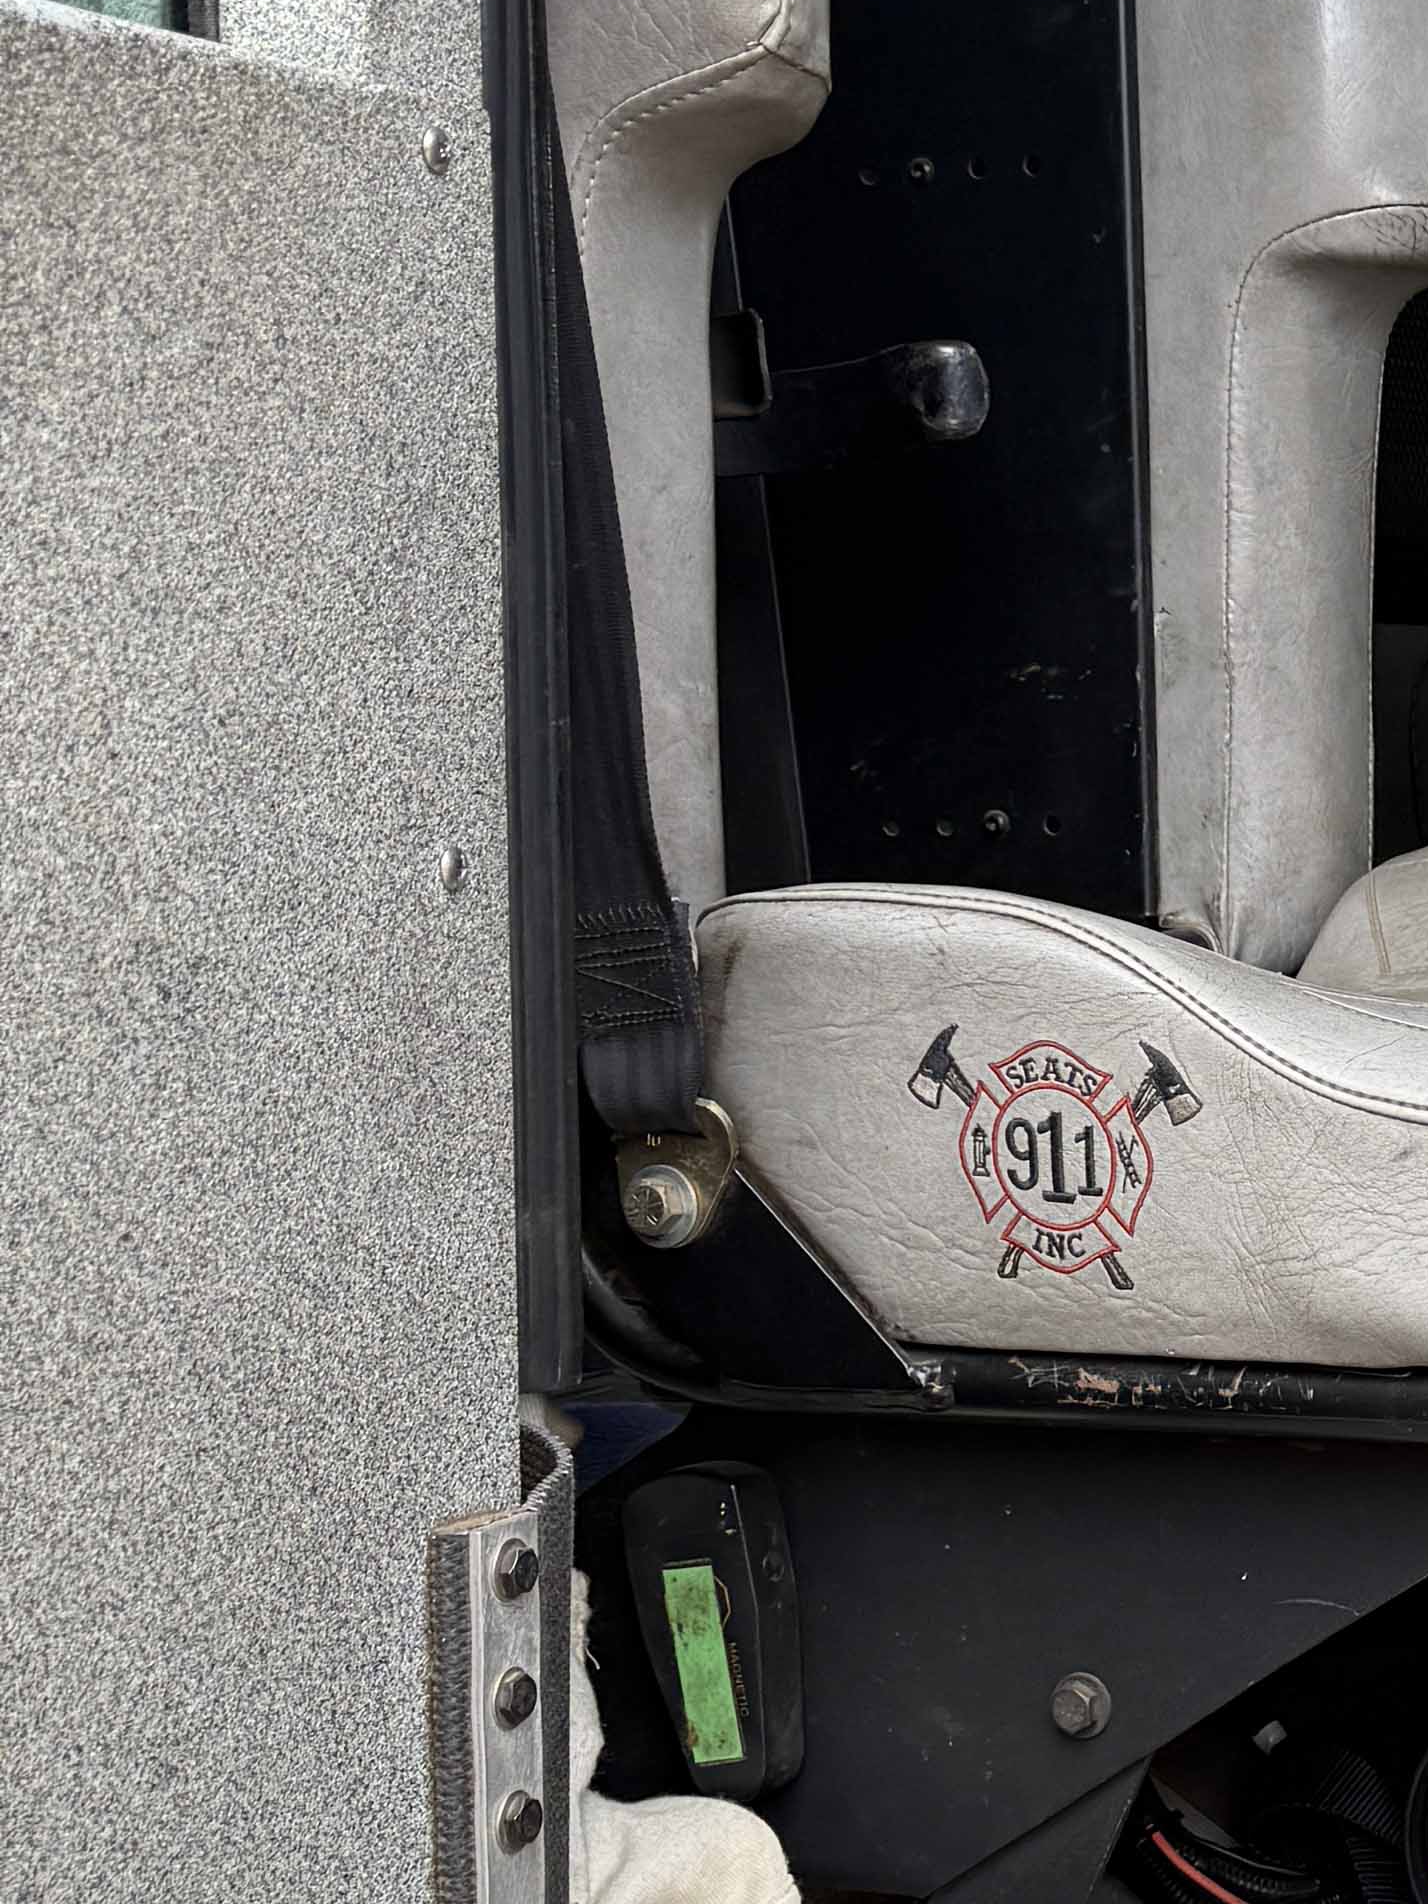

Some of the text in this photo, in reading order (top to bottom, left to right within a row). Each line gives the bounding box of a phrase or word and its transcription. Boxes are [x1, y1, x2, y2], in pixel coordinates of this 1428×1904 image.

[1005, 1057, 1098, 1100] SEATS
[1004, 1111, 1104, 1205] 911
[1032, 1229, 1086, 1260] INC
[727, 1640, 750, 1720] MAGNETIC
